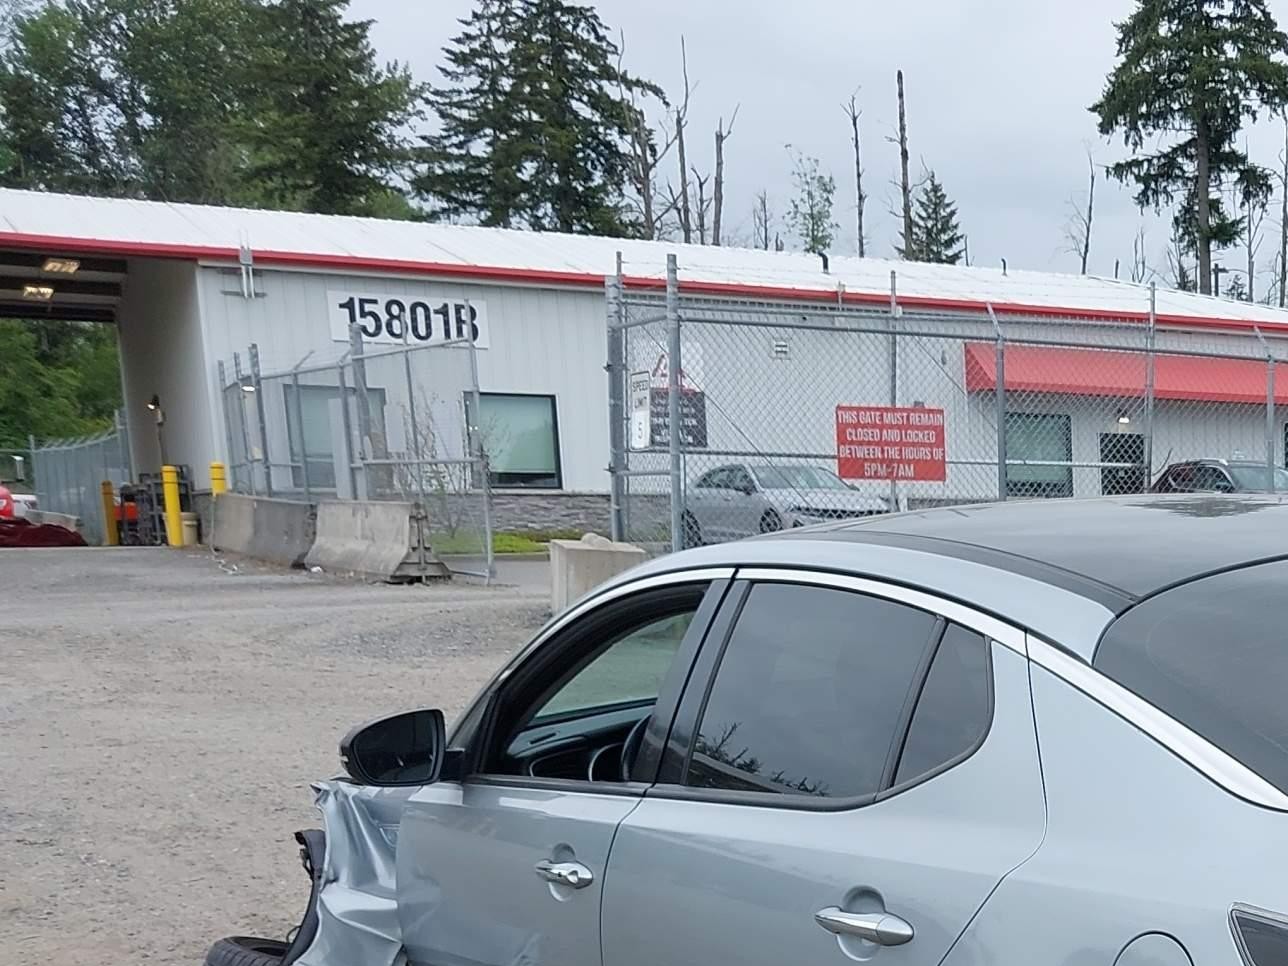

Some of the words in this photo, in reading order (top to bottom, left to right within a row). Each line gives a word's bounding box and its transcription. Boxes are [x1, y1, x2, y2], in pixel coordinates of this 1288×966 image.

[338, 297, 479, 342] 15801B
[632, 380, 649, 392] SPEED
[838, 410, 857, 424] THIS
[859, 411, 880, 424] GATE
[883, 413, 908, 425] MUST
[910, 413, 943, 426] REMAIN
[637, 421, 643, 440] 5
[846, 428, 880, 441] CLOSED
[882, 429, 900, 442] AND
[903, 431, 936, 443] LOCKED
[840, 445, 881, 458] BETWEEN
[884, 446, 900, 459] THE
[903, 447, 931, 460] HOURS
[933, 448, 944, 460] OF
[865, 463, 914, 477] 5PM-7AM
